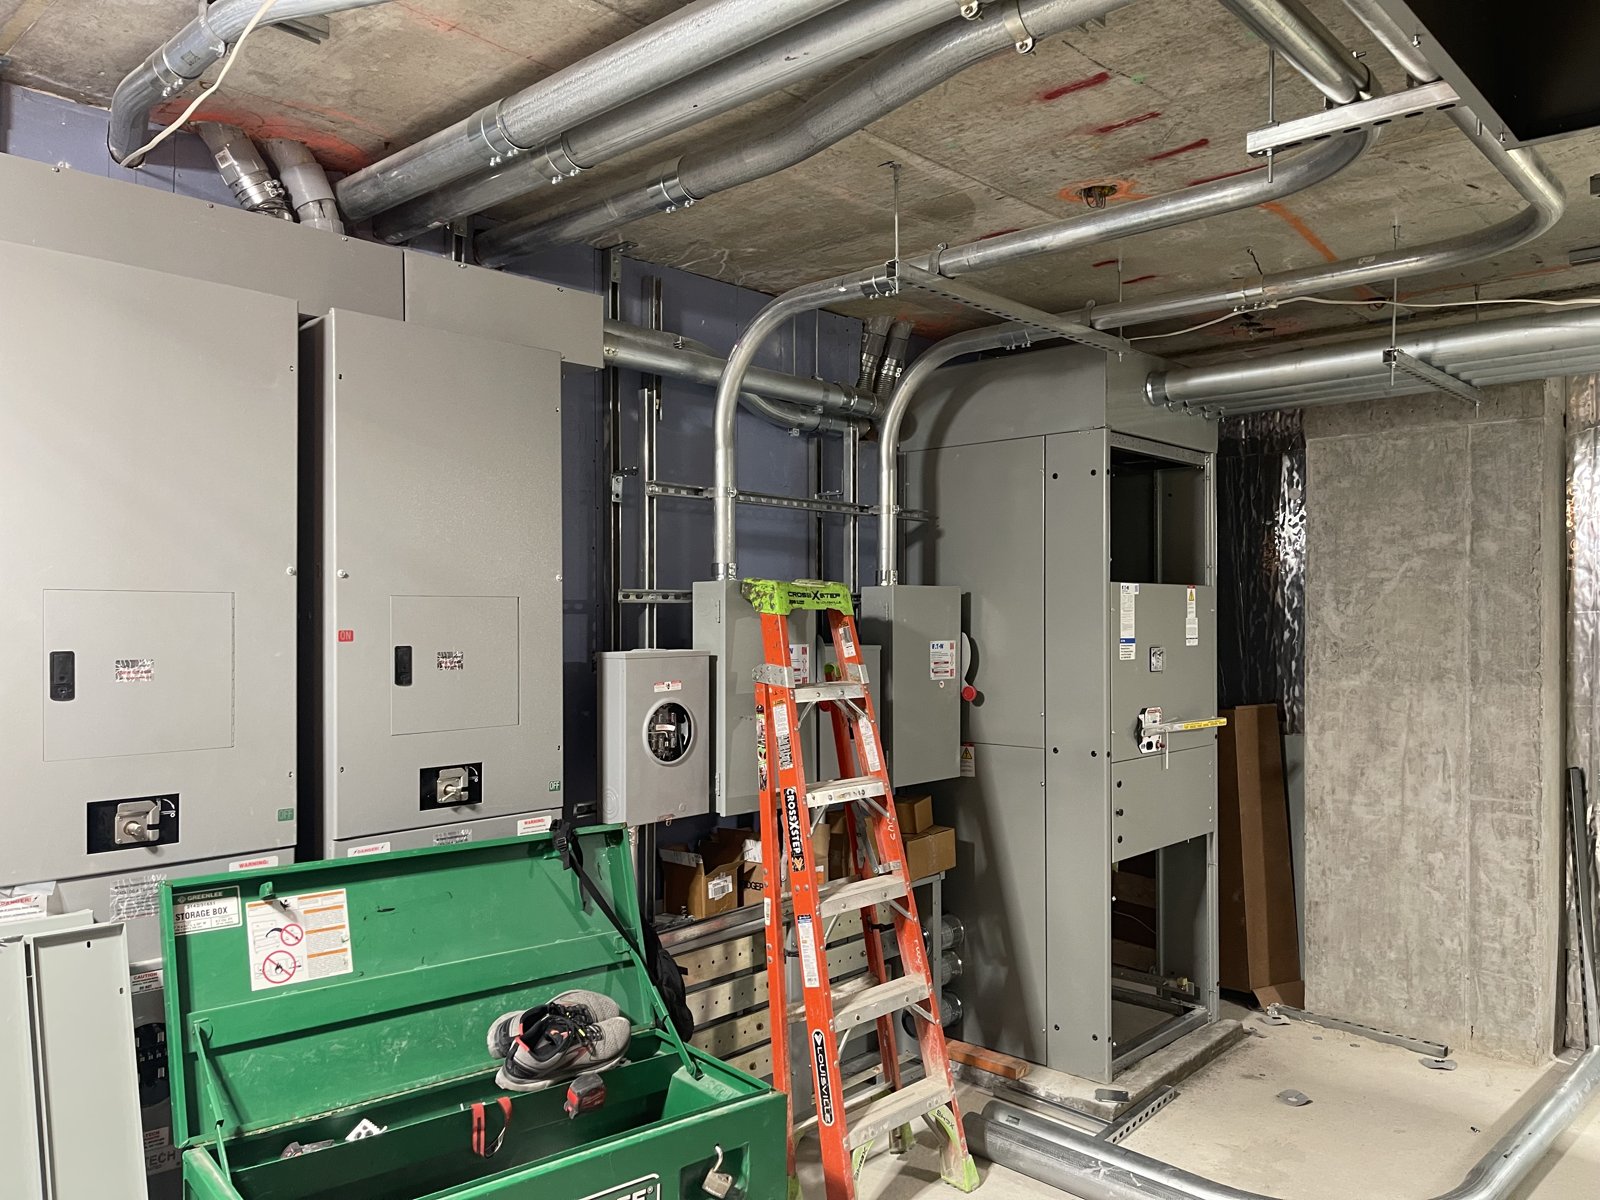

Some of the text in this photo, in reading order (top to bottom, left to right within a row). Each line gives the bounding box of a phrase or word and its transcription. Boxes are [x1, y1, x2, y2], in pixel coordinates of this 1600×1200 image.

[340, 631, 351, 641] ON
[550, 781, 560, 791] OFF
[786, 788, 802, 854] CROSSXSTEP
[187, 891, 223, 901] GREENLEE
[175, 906, 228, 921] STORAGE BOX
[133, 972, 158, 980] CAUTION
[816, 1046, 831, 1123] LOUISVILLE
